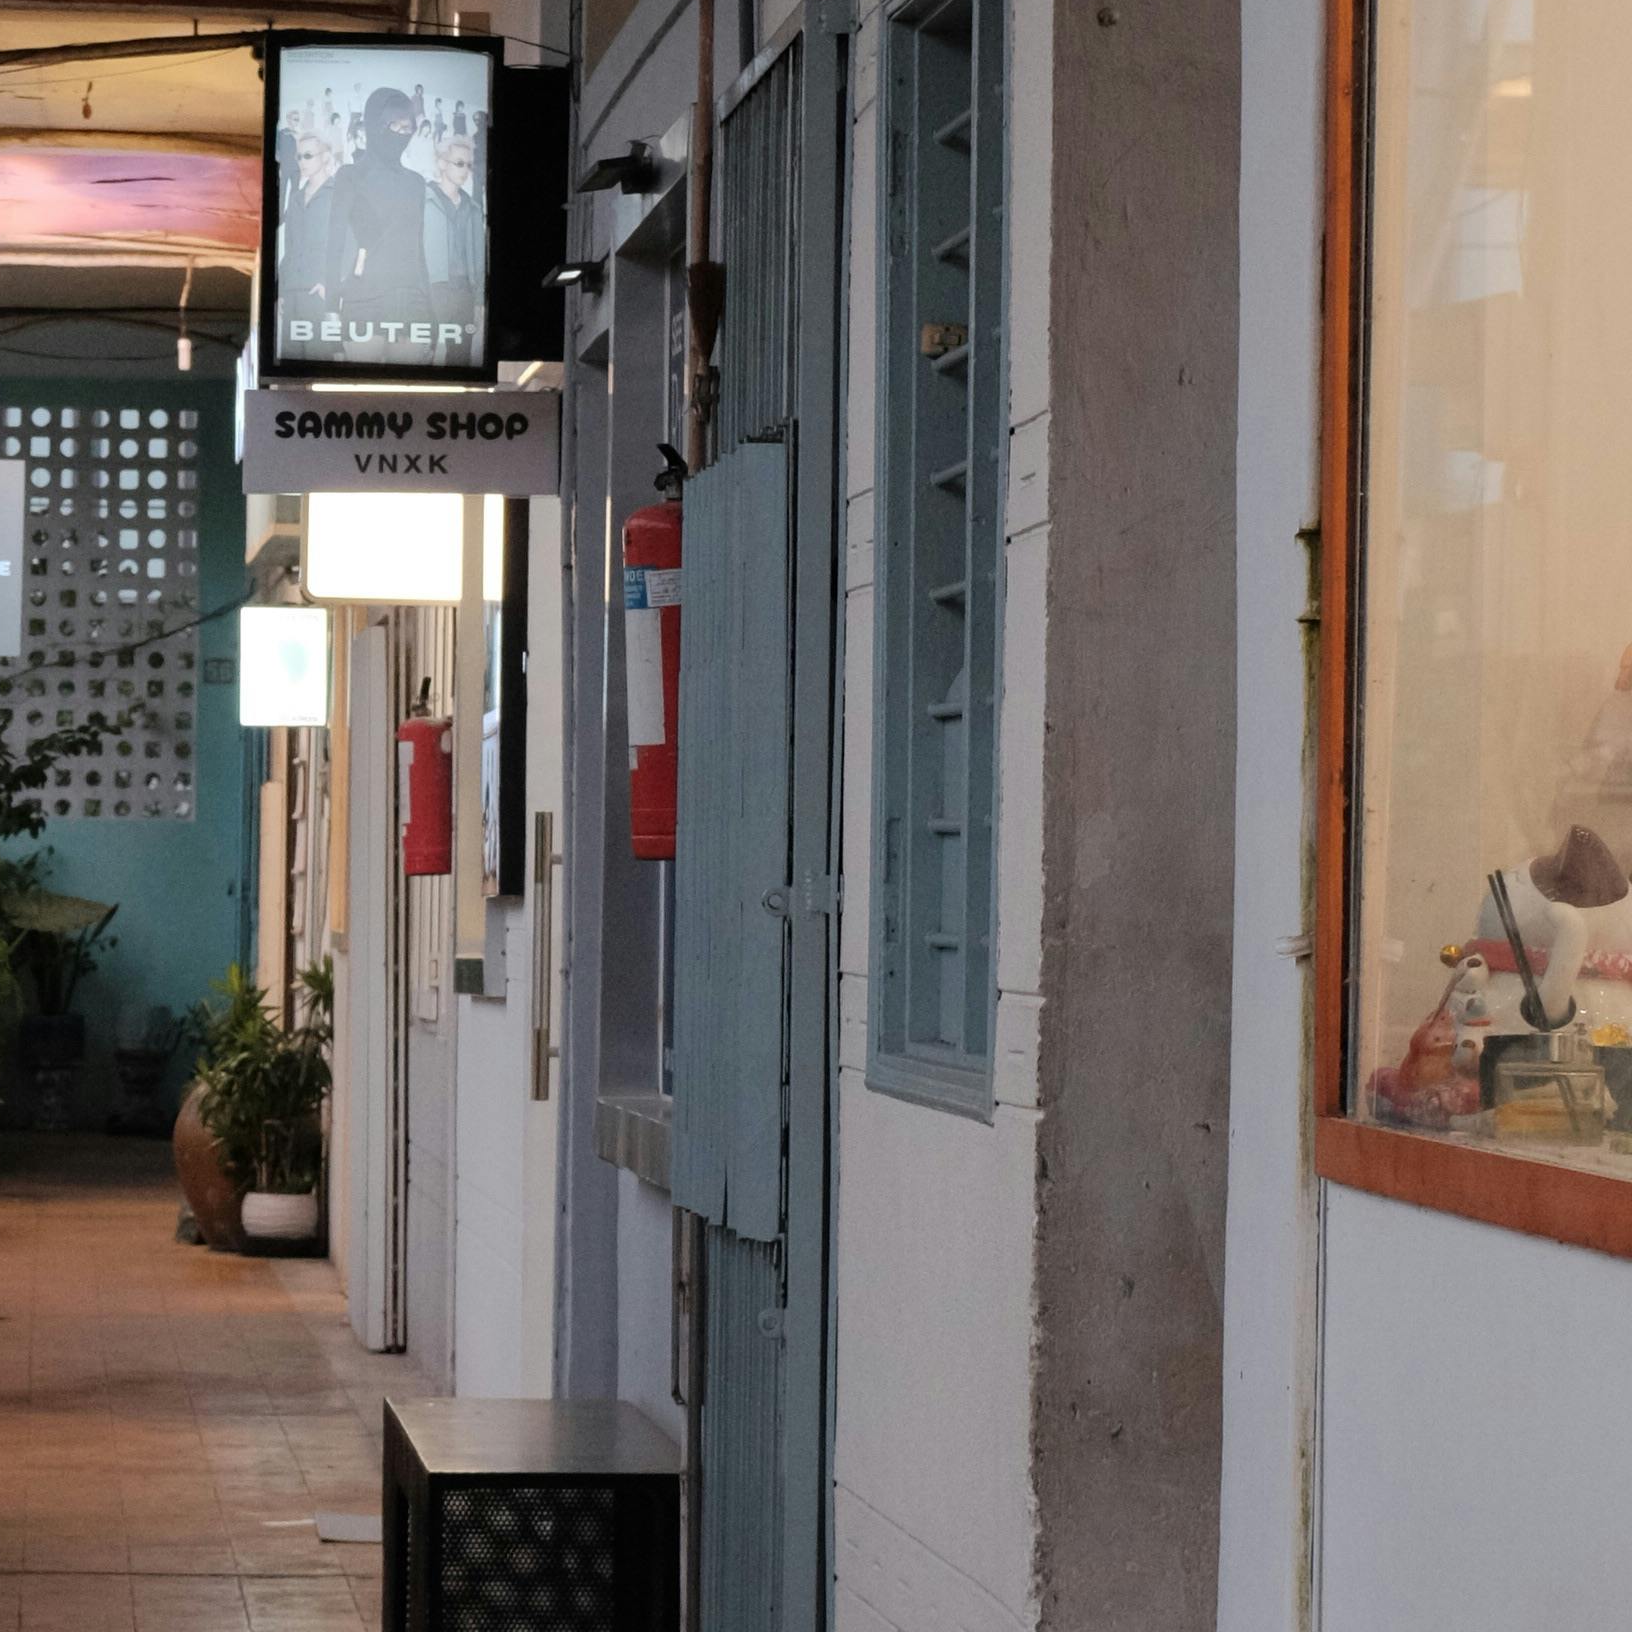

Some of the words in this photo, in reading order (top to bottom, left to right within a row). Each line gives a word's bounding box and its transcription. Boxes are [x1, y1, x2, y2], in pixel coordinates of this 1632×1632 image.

[274, 410, 413, 440] SAMMY
[426, 411, 529, 441] SHOP
[354, 453, 449, 475] VNXK
